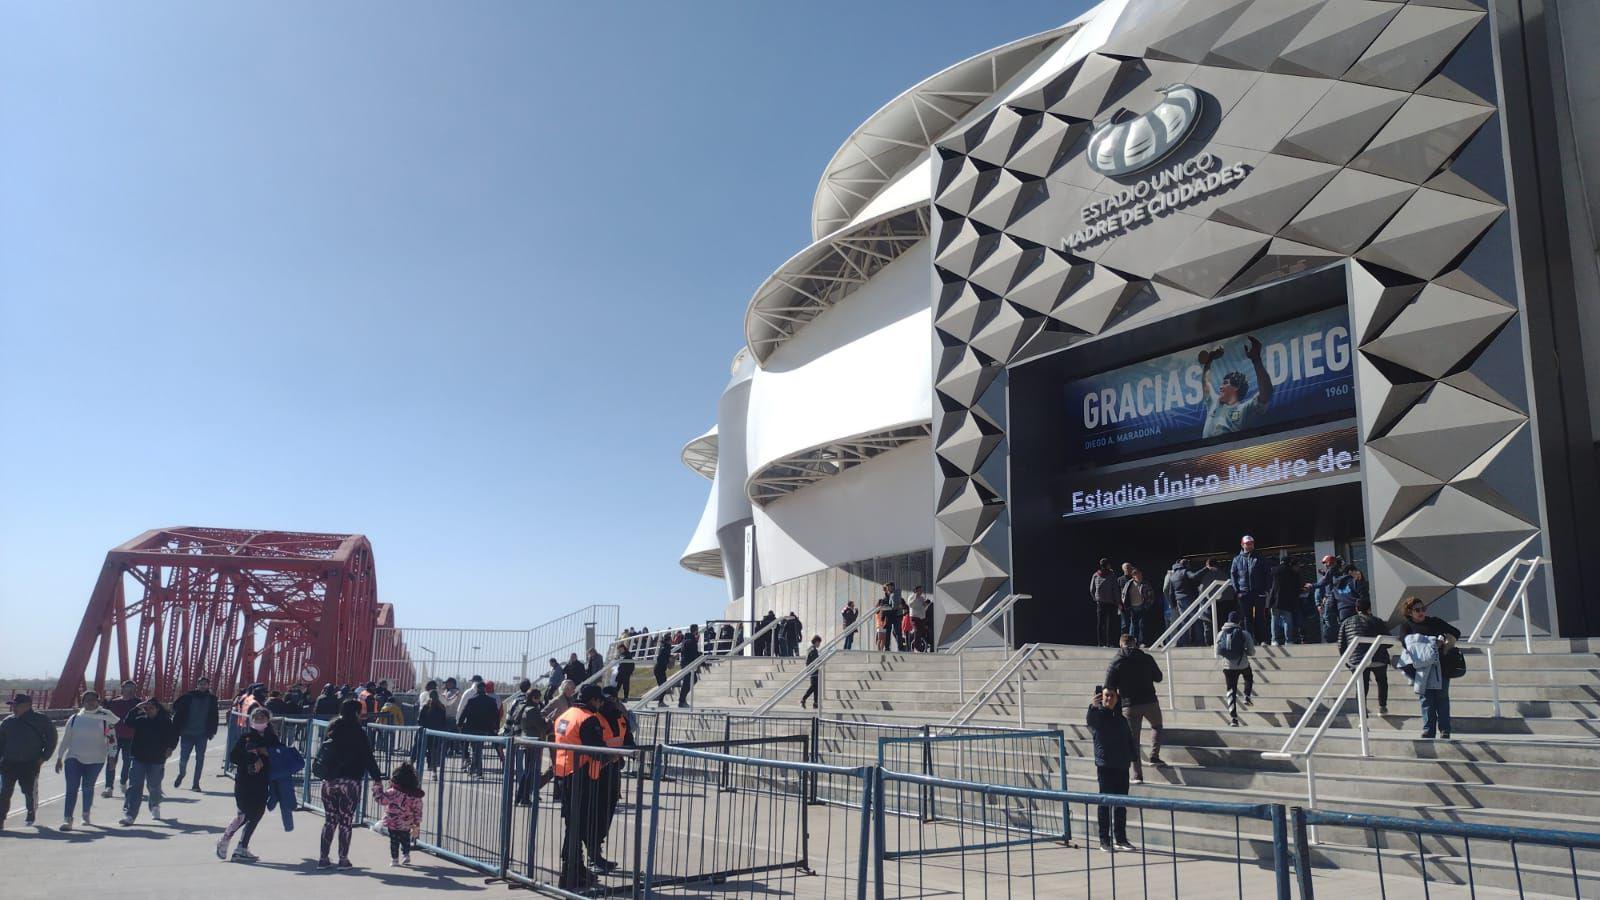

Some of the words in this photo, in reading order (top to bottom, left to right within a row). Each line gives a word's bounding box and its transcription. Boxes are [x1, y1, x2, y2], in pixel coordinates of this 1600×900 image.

[1060, 217, 1120, 250] MADRE
[1121, 205, 1146, 229] DE
[1147, 161, 1246, 215] CIUDADES
[1081, 180, 1150, 222] ESTADIO
[1151, 151, 1213, 191] UNICO
[1083, 364, 1204, 430] GRACIAS
[1325, 384, 1349, 398] 1960
[1085, 437, 1106, 450] DIEGO
[1116, 425, 1162, 442] MARADONA
[1072, 484, 1147, 512] Estadio
[1153, 471, 1221, 500] Único
[1228, 457, 1309, 487] Madre
[1316, 447, 1352, 473] de
